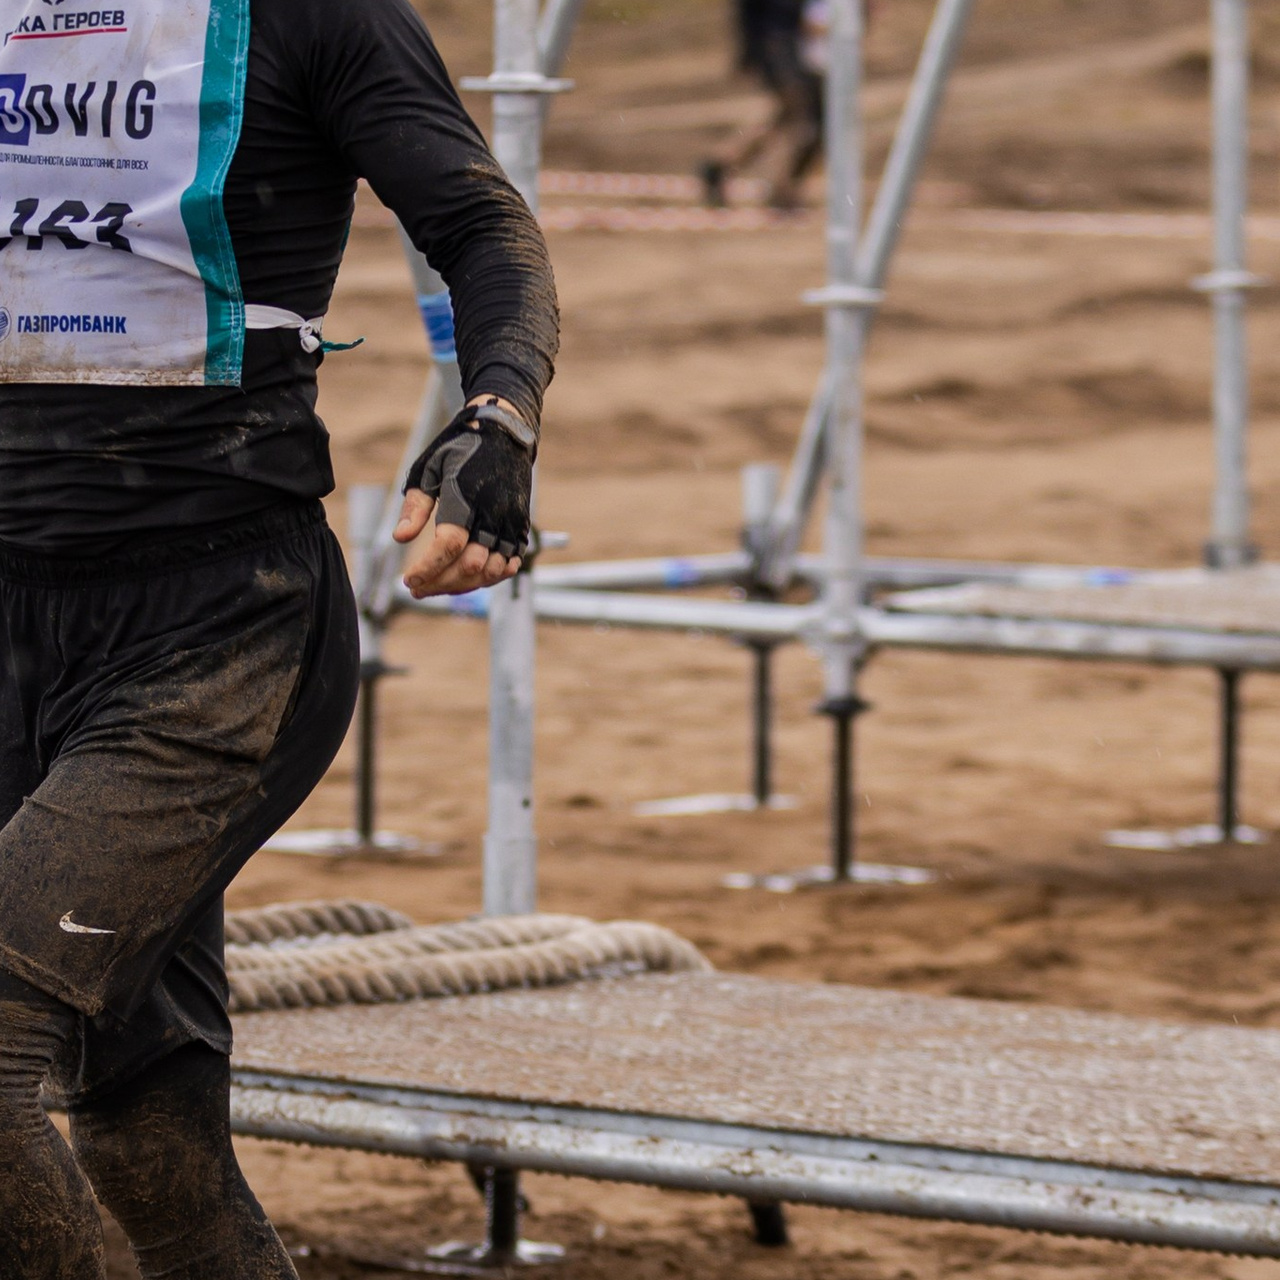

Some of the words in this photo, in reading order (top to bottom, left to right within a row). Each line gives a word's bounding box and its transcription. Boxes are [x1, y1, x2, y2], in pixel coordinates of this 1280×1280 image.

[53, 10, 125, 31] ГЕРОЕВ
[131, 160, 149, 171] ВСЕХ
[17, 315, 127, 334] ГАЗПРОМБАНК
